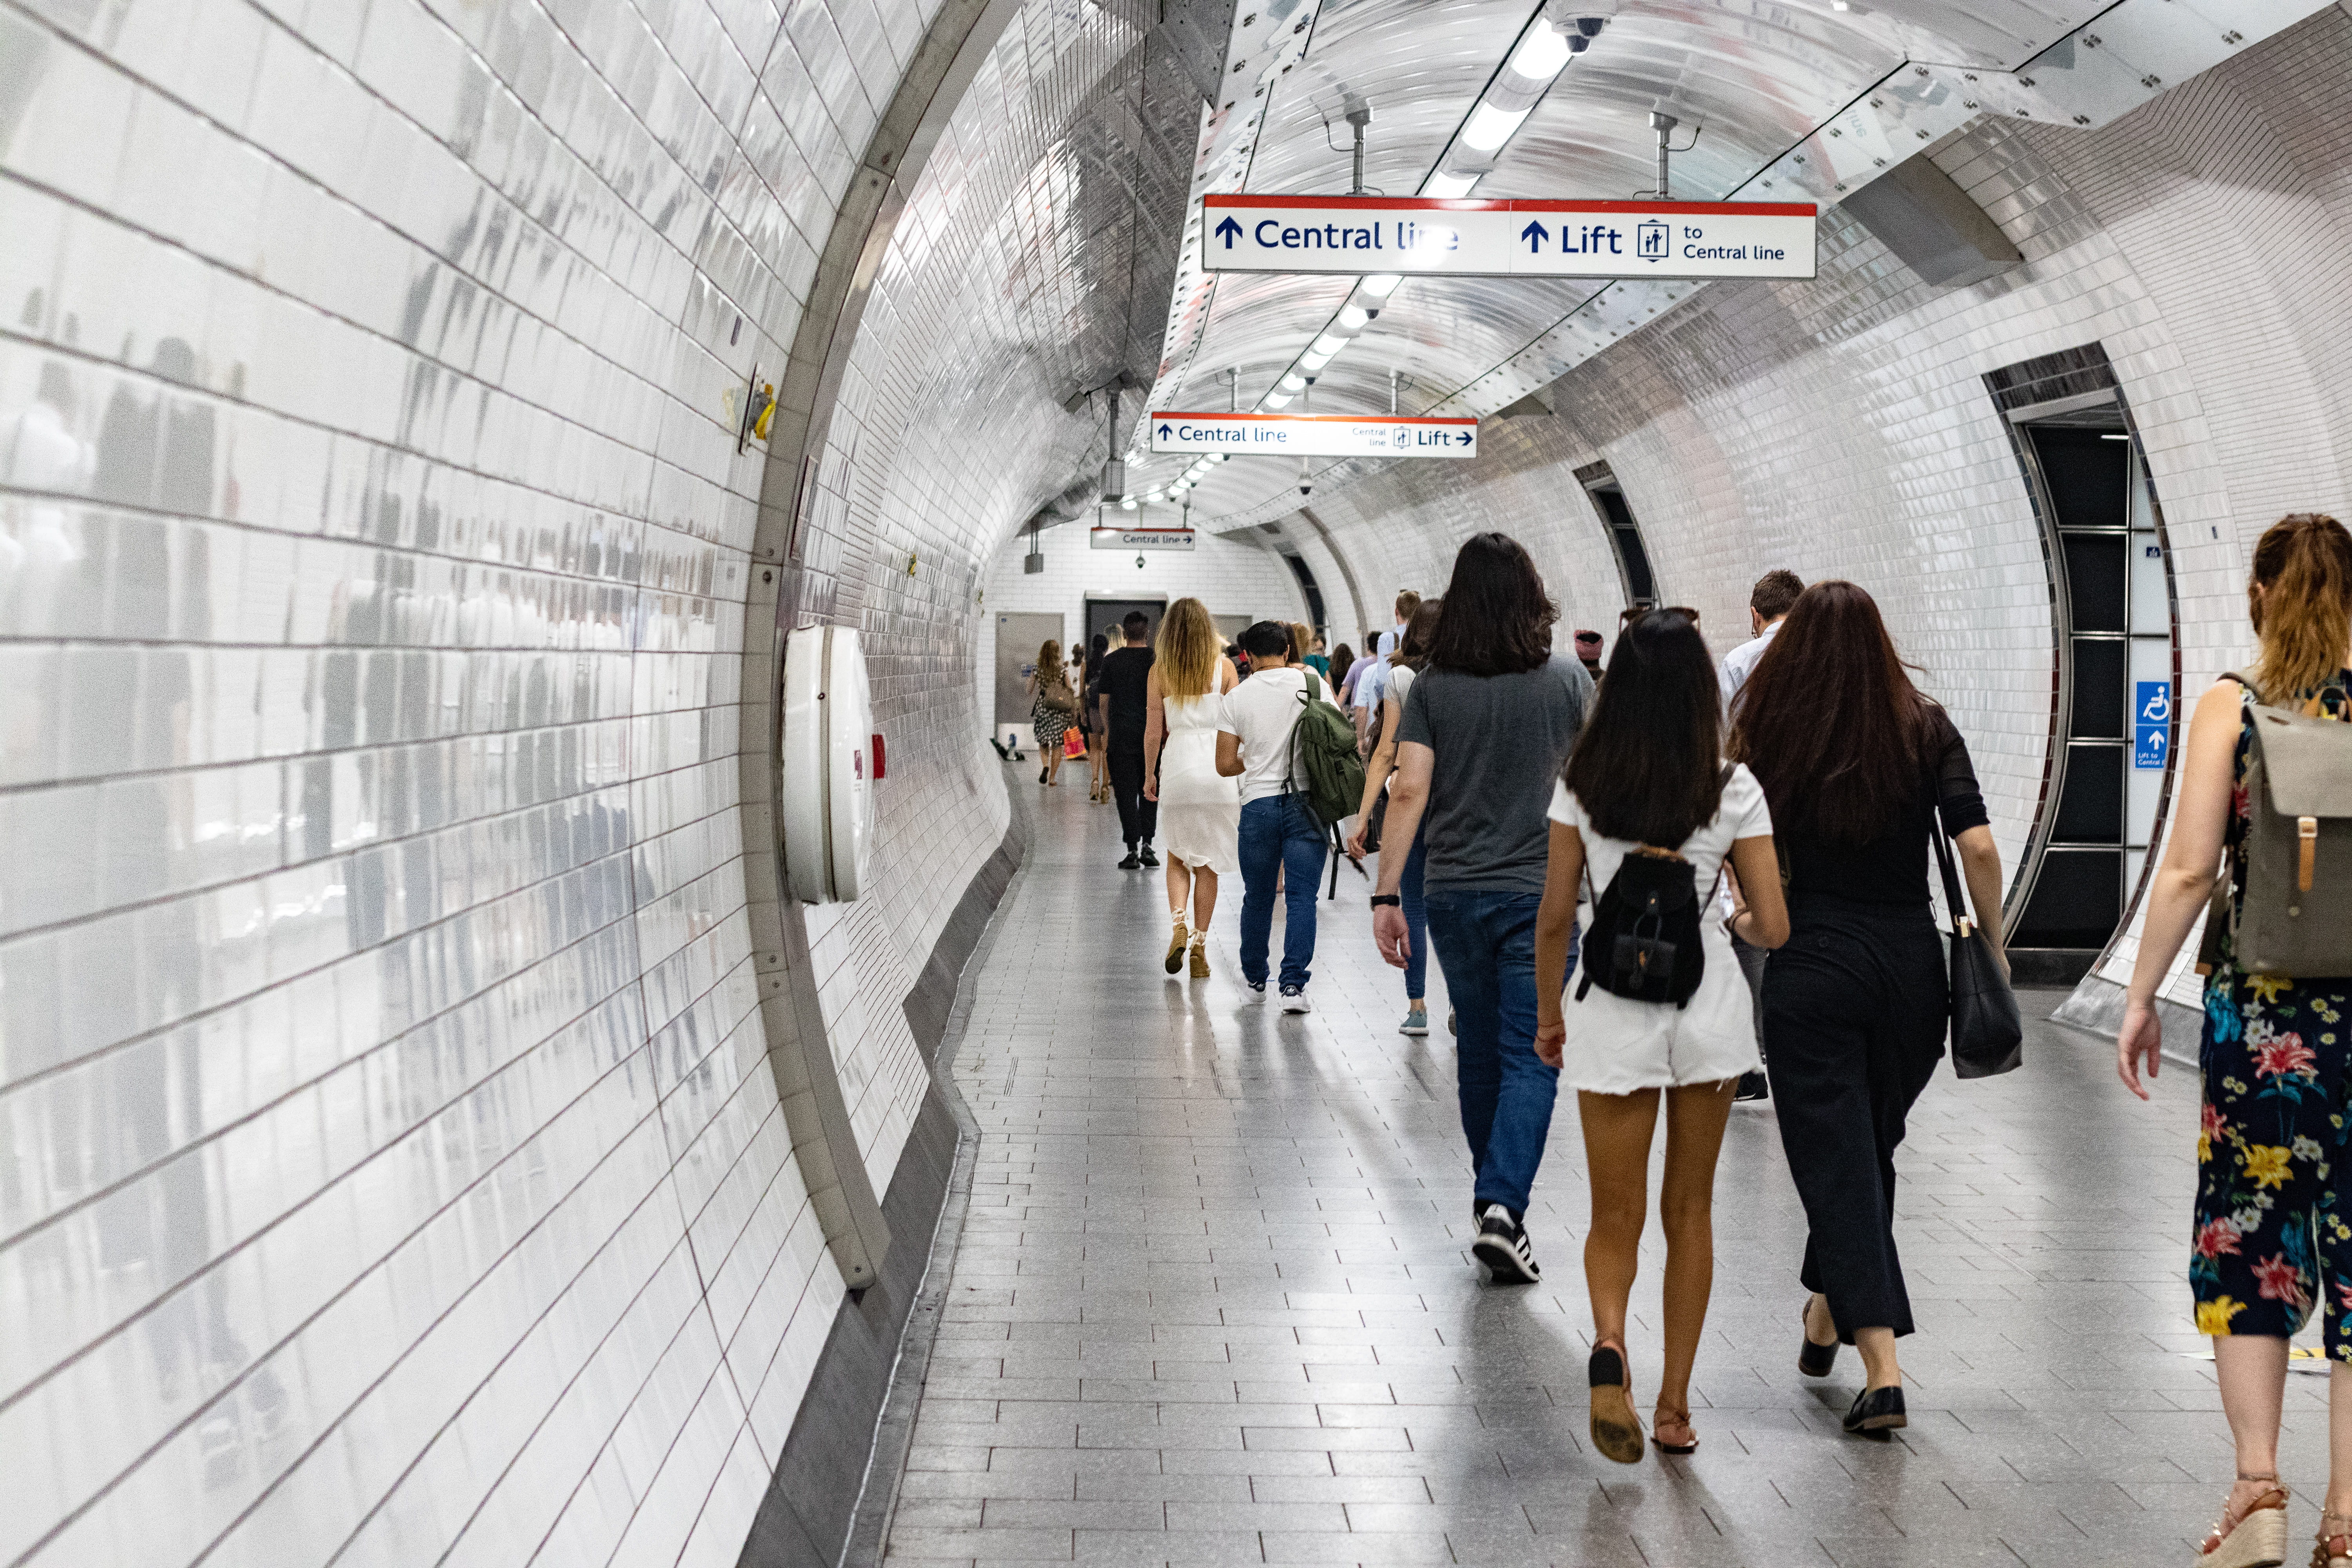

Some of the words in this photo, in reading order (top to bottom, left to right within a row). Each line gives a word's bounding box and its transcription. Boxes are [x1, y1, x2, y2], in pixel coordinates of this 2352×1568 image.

[1255, 220, 1382, 250] Central
[1397, 221, 1459, 250] lie
[1562, 225, 1622, 255] Lift
[1683, 225, 1703, 239] to
[1683, 244, 1747, 260] Central
[1754, 245, 1785, 260] line
[1179, 426, 1247, 442] Central
[1254, 427, 1287, 442] line
[1352, 428, 1386, 436] Central
[1418, 430, 1450, 446] Lift
[1123, 534, 1159, 544] Central
[1163, 535, 1181, 544] line
